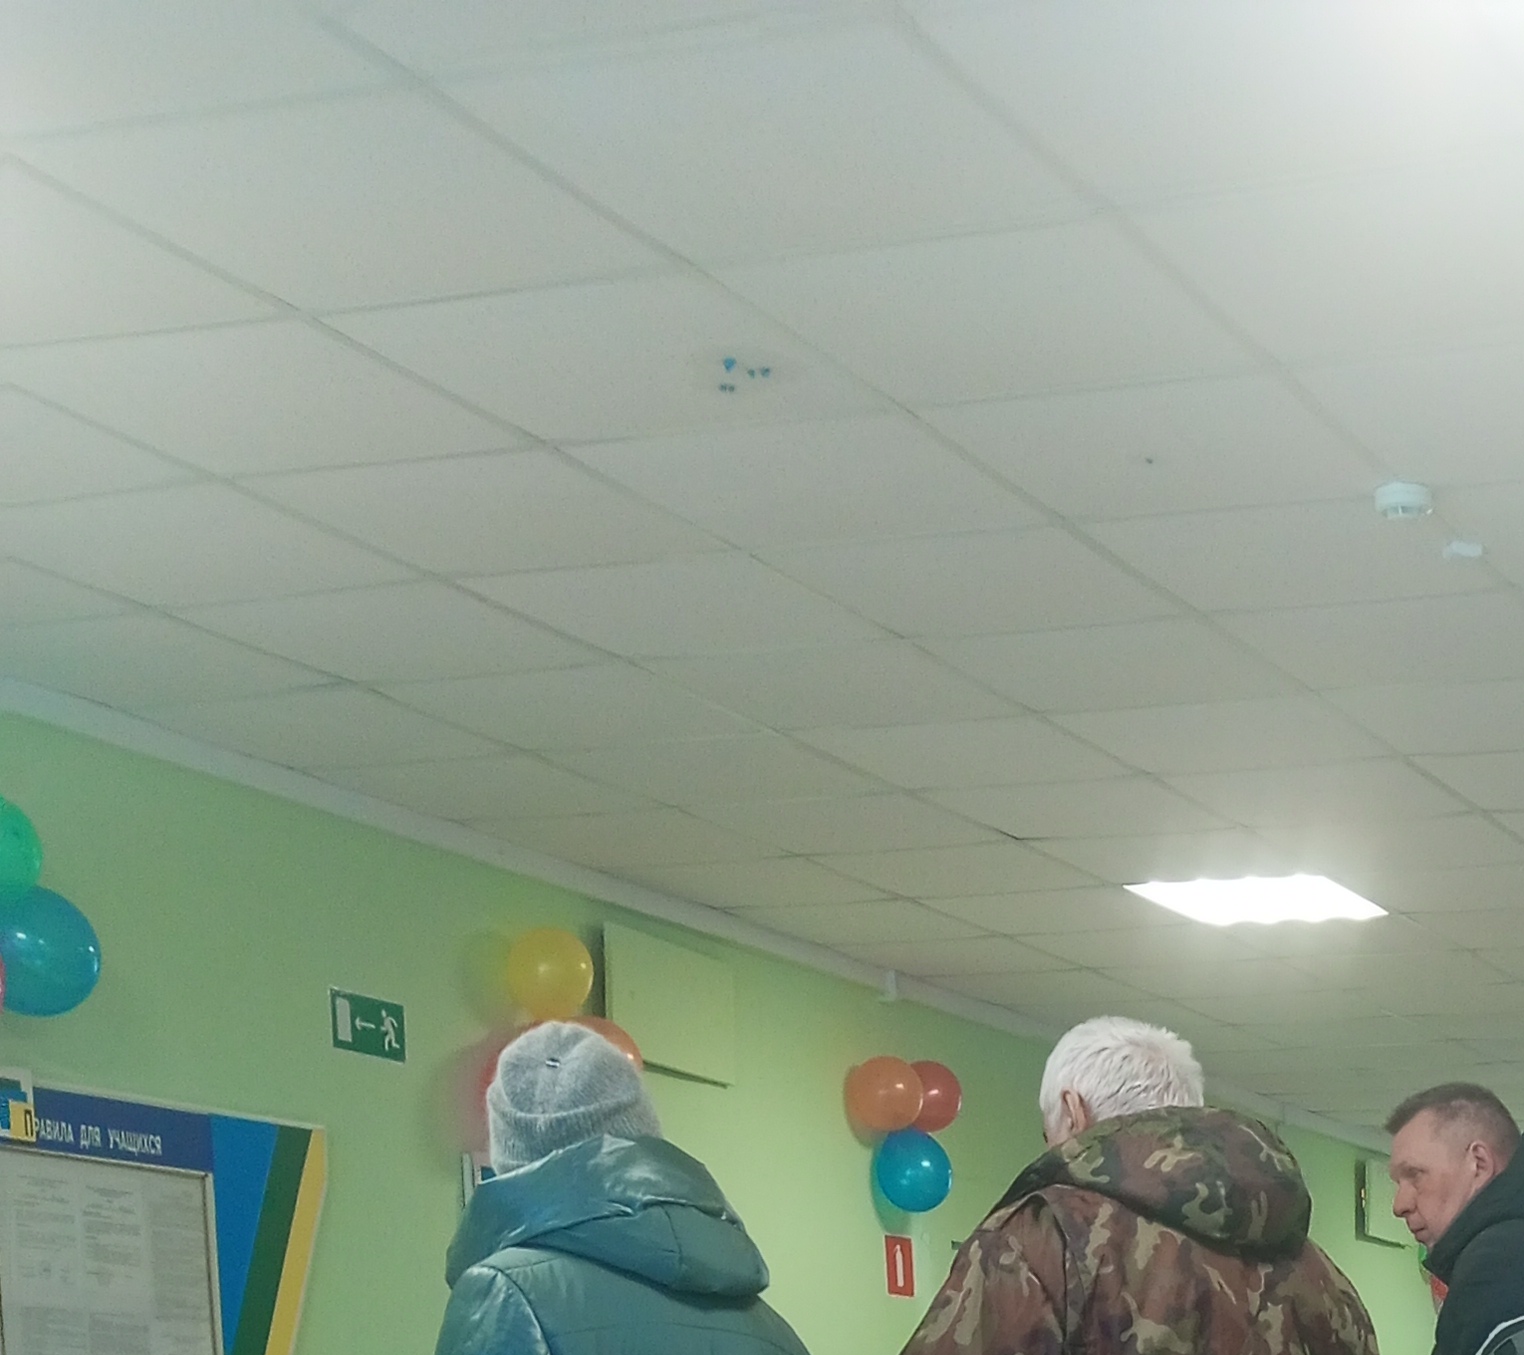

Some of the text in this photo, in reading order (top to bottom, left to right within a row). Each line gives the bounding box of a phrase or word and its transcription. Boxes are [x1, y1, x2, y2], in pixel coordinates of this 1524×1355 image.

[24, 1109, 163, 1157] ПРАВИЛА ДЛЯ УЧАЩИХСЯ
